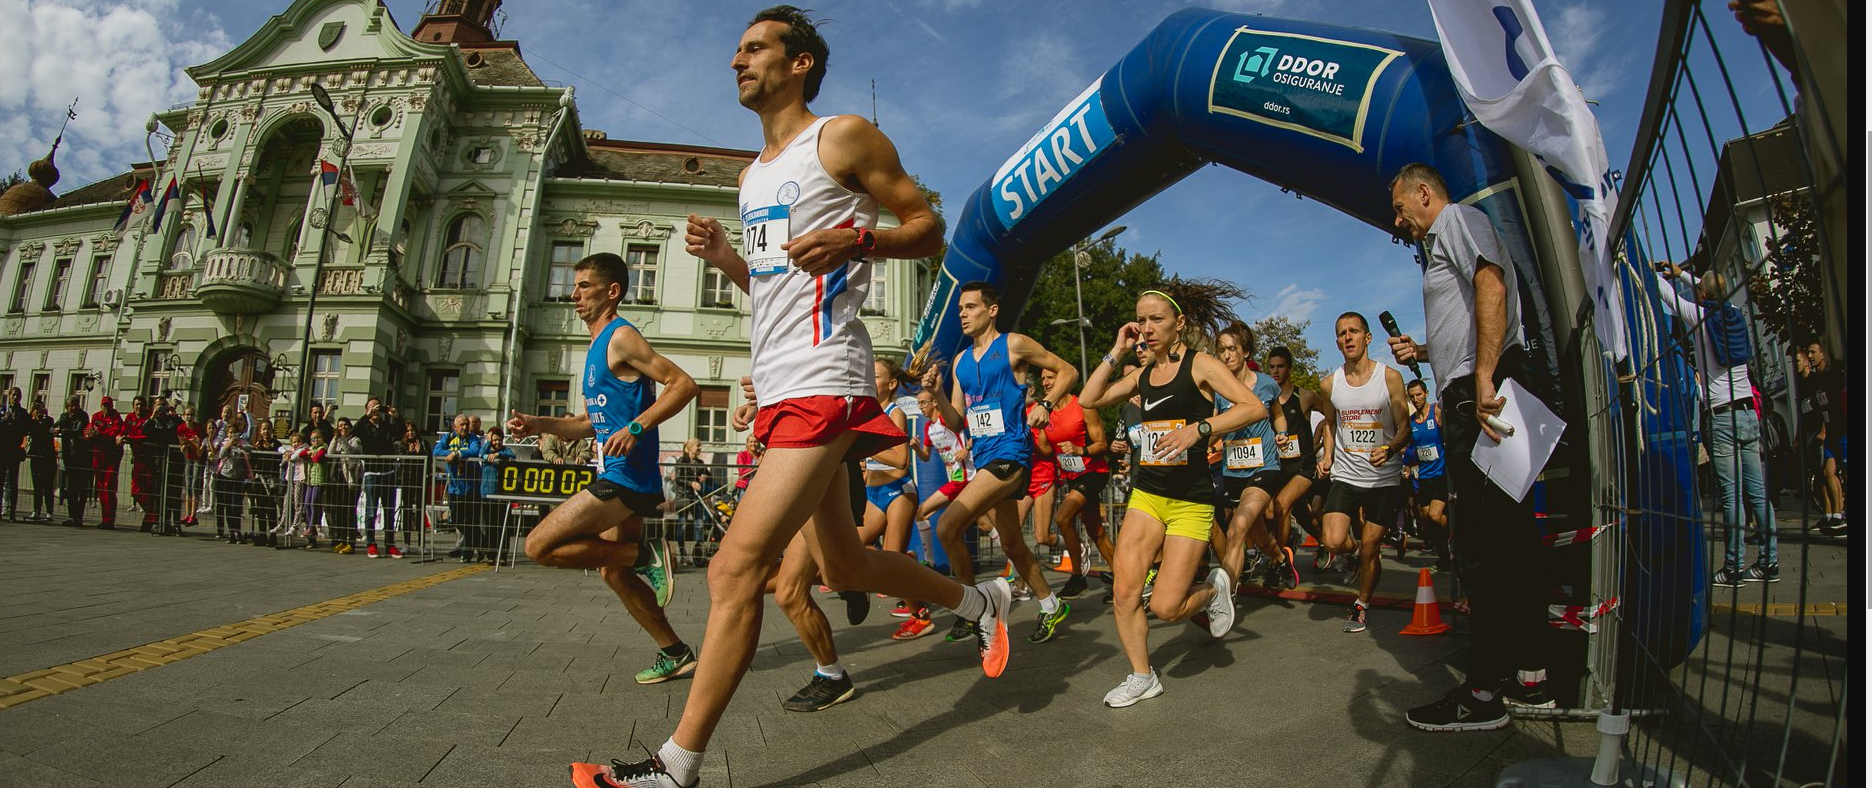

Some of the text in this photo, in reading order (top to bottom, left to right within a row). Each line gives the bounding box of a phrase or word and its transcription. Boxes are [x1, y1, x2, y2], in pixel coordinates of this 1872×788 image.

[1277, 54, 1340, 80] DDOR
[1273, 72, 1345, 96] OSIGURANJE
[1263, 101, 1291, 115] ddor.rs
[1001, 103, 1097, 220] START
[746, 223, 767, 255] 274
[1341, 408, 1383, 416] SUPPLEMENT
[975, 412, 992, 428] 142
[1350, 430, 1376, 443] 1222
[1232, 445, 1256, 460] 1094
[1421, 448, 1432, 458] 220
[1062, 457, 1077, 467] 201
